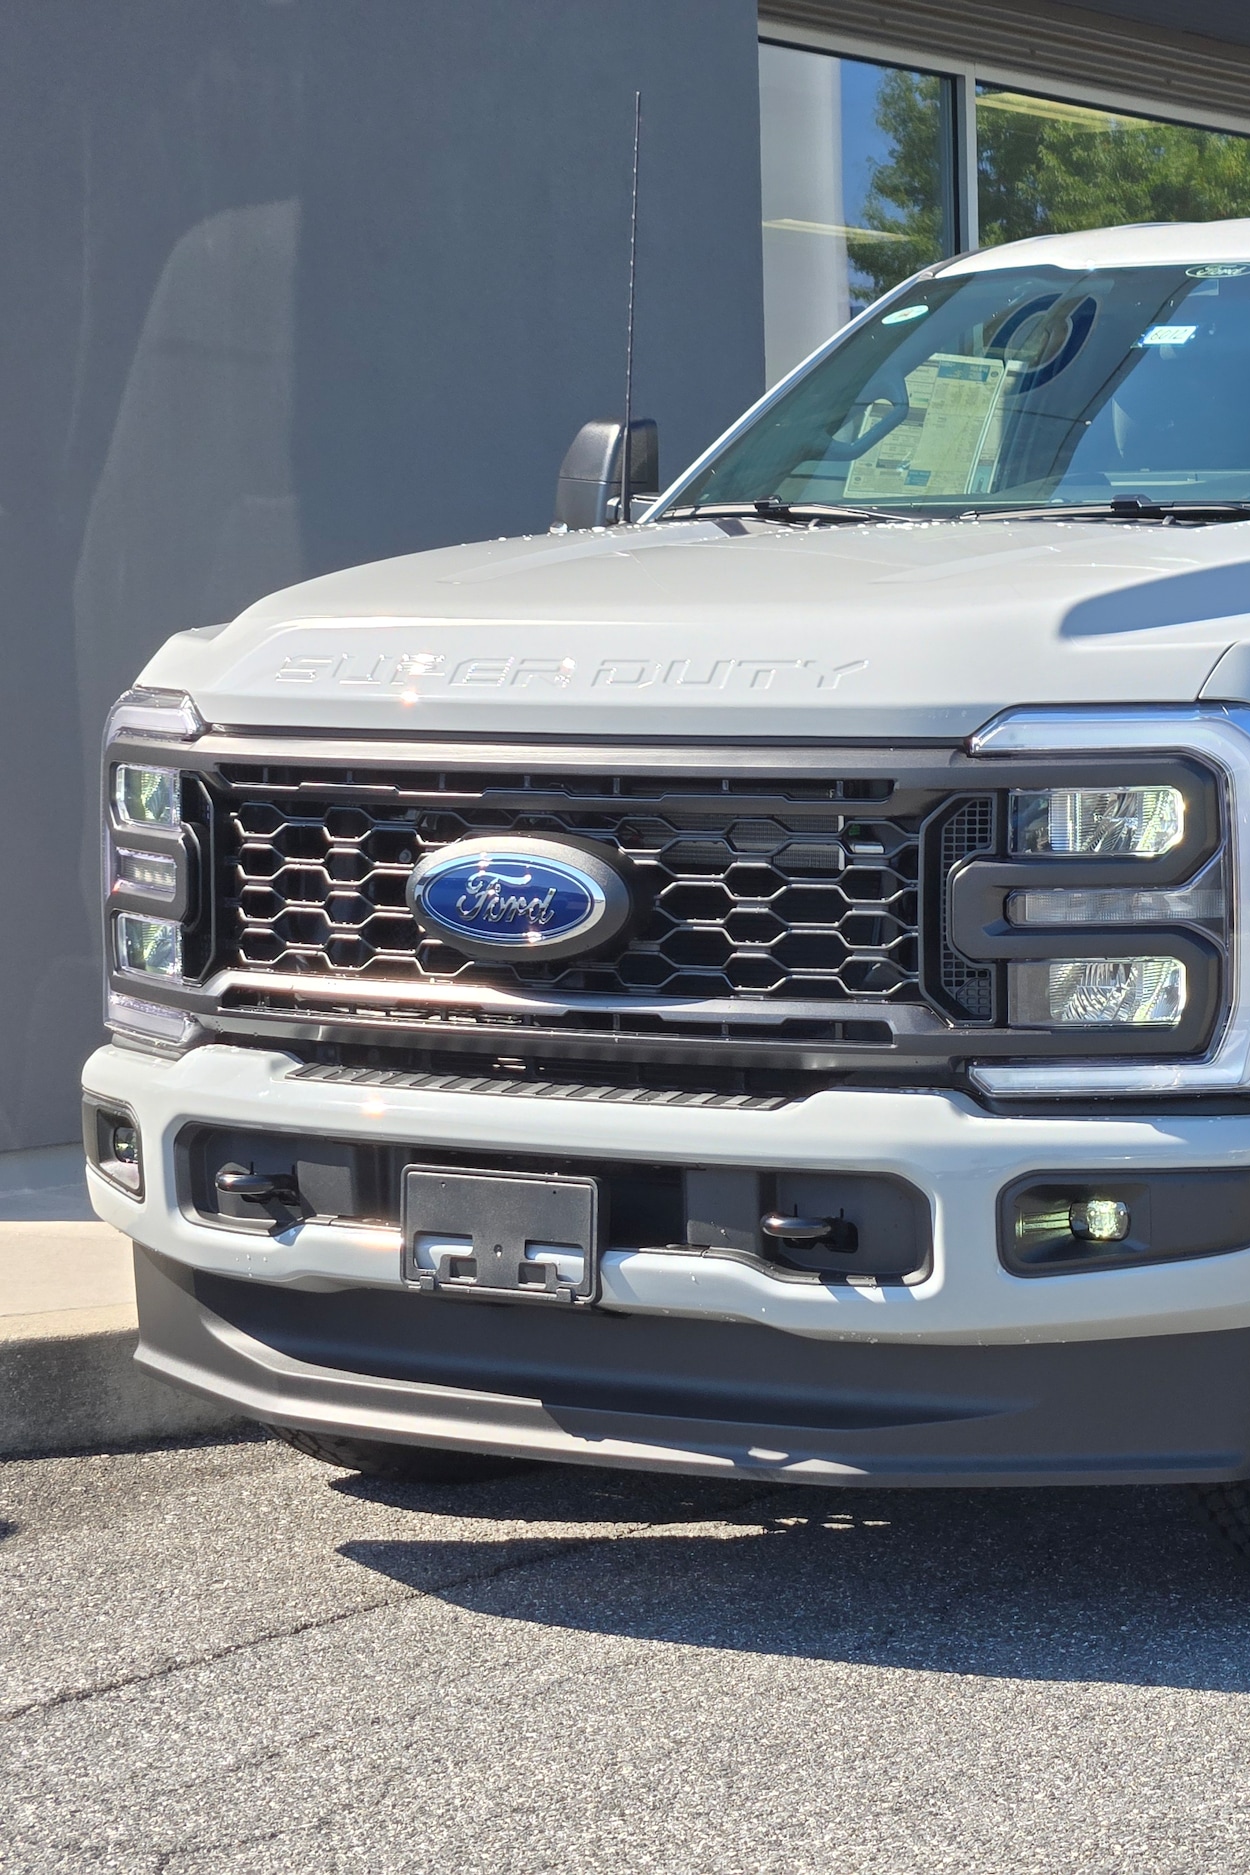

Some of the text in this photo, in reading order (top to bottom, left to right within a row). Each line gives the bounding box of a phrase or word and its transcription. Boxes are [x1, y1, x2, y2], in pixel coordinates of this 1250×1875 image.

[275, 653, 869, 690] SUPER DUTY
[456, 870, 557, 925] Ford
